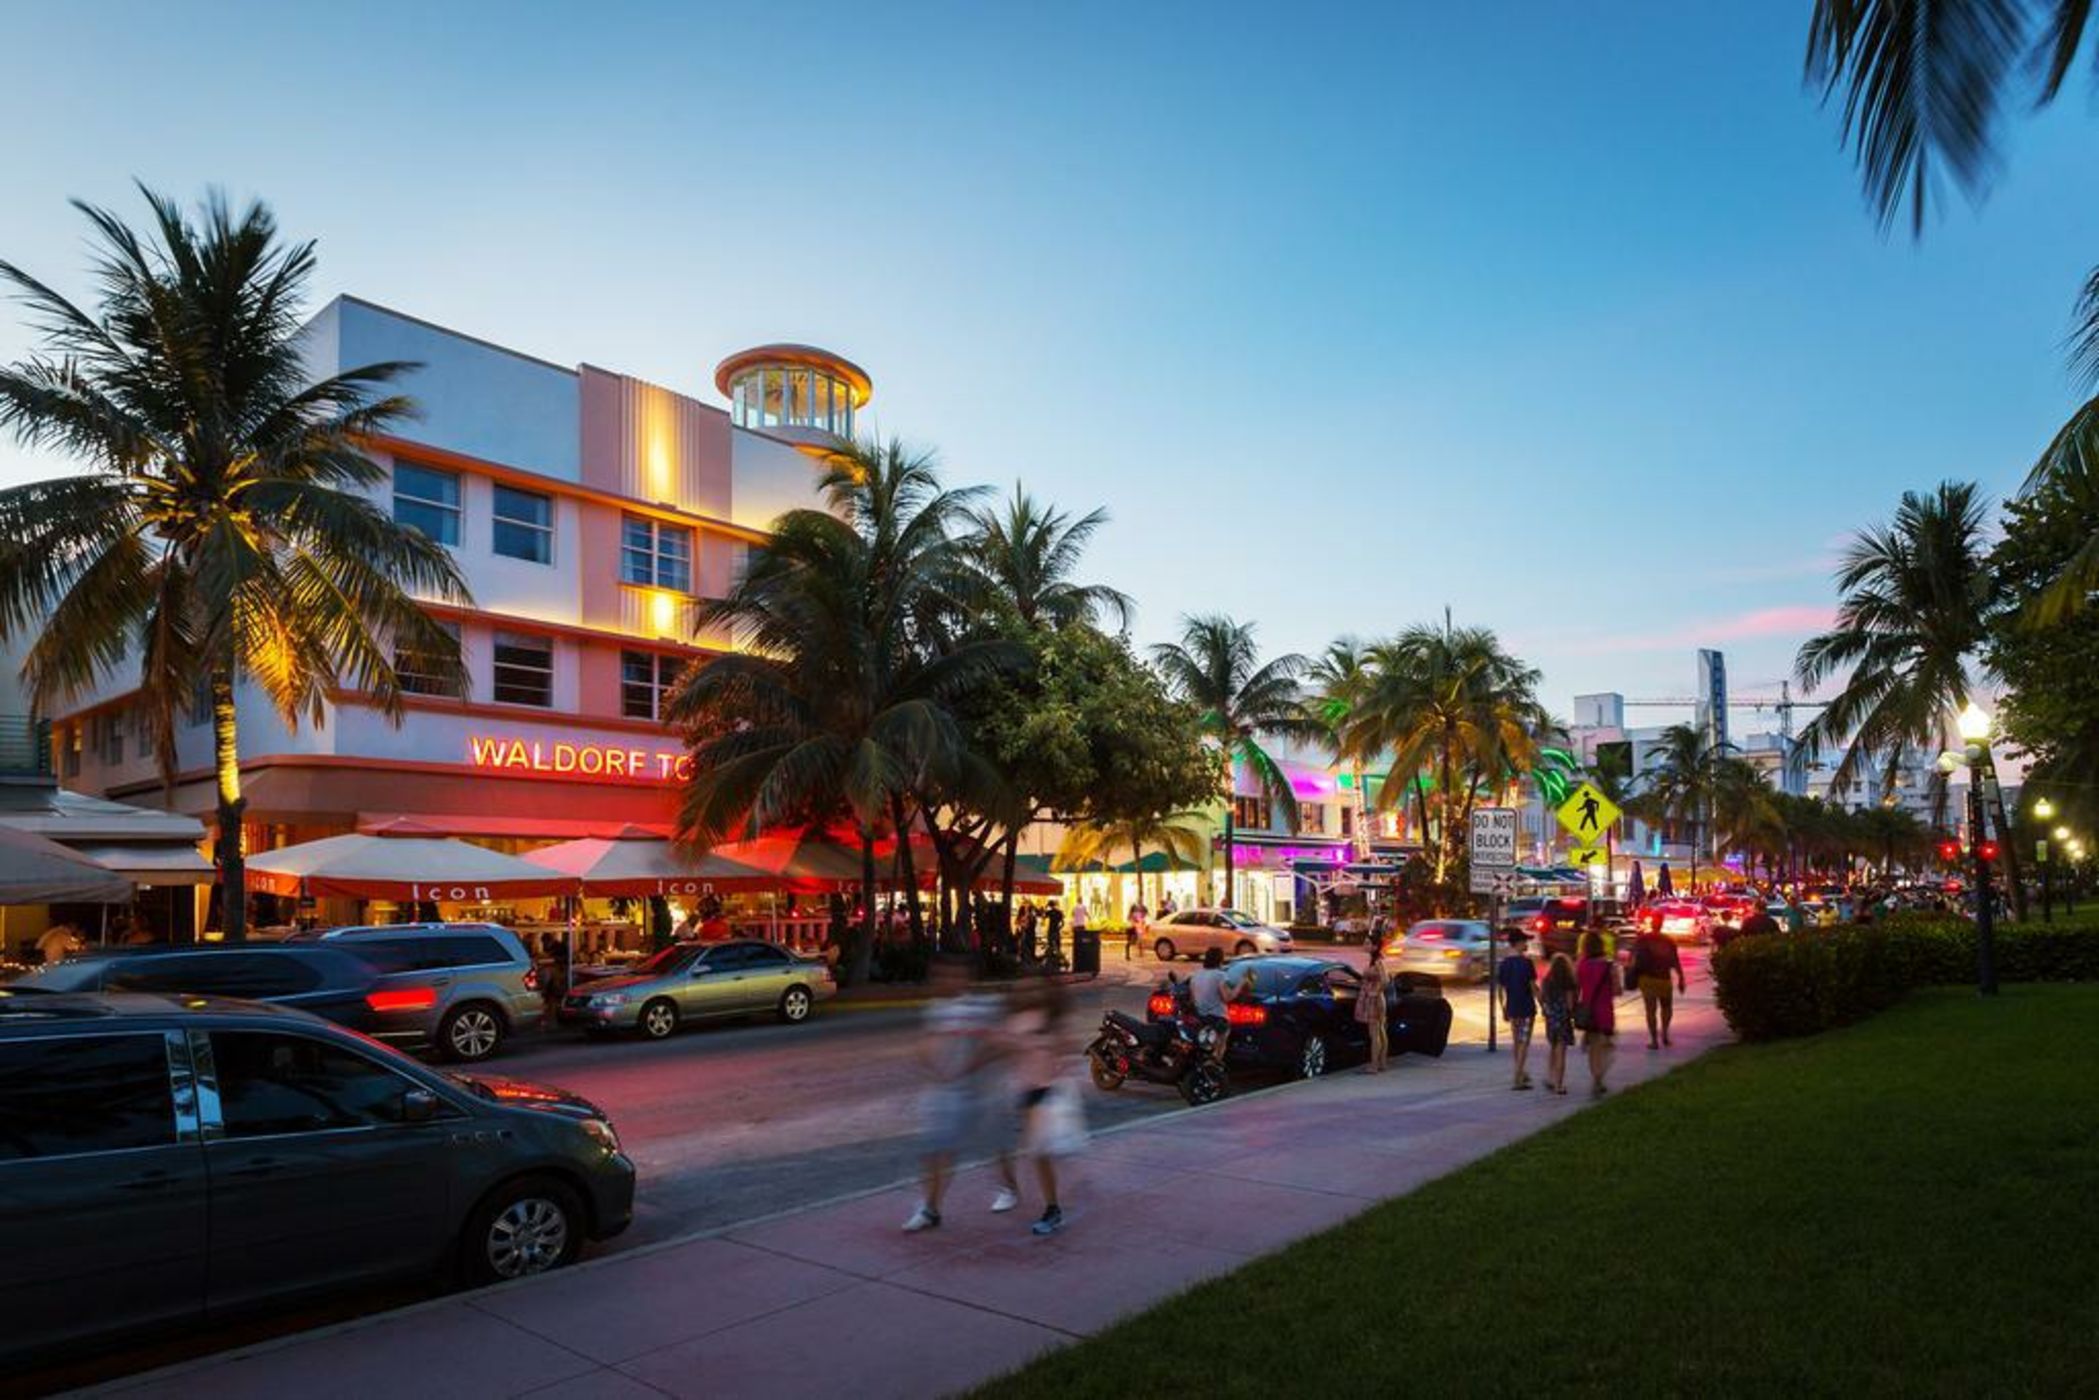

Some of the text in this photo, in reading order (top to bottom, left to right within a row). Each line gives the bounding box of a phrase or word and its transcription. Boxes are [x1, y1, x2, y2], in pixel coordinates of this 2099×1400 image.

[471, 736, 646, 776] WALDORF
[1474, 815, 1514, 828] DO NOT
[1476, 834, 1511, 848] BLOCK
[412, 883, 490, 900] Icon
[658, 880, 713, 894] Icon
